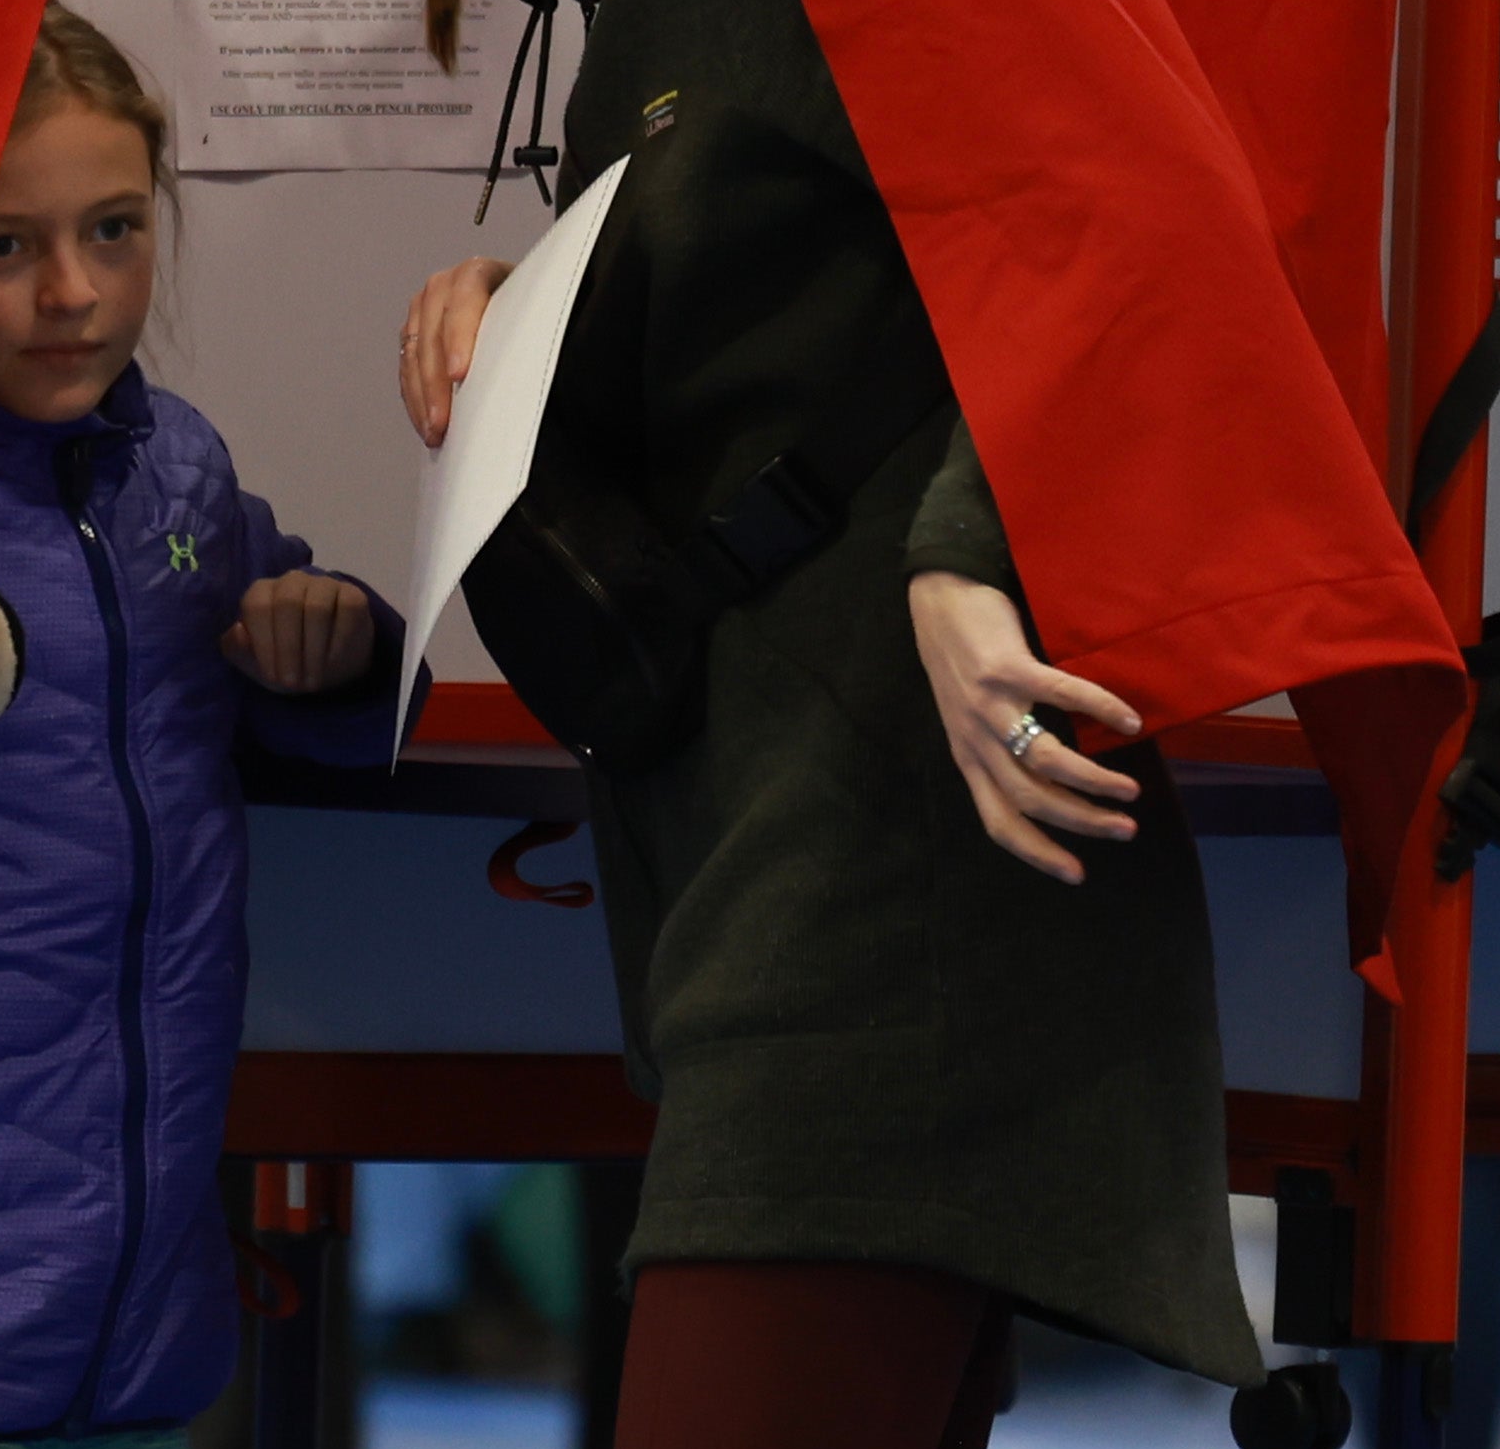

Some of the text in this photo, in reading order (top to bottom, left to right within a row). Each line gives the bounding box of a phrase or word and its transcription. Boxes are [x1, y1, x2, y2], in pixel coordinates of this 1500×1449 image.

[233, 104, 263, 115] ONLY
[268, 104, 285, 115] THE
[288, 104, 330, 115] SPECIAL
[333, 103, 354, 115] PEN
[356, 103, 372, 115] OR
[374, 103, 413, 115] PENCIL
